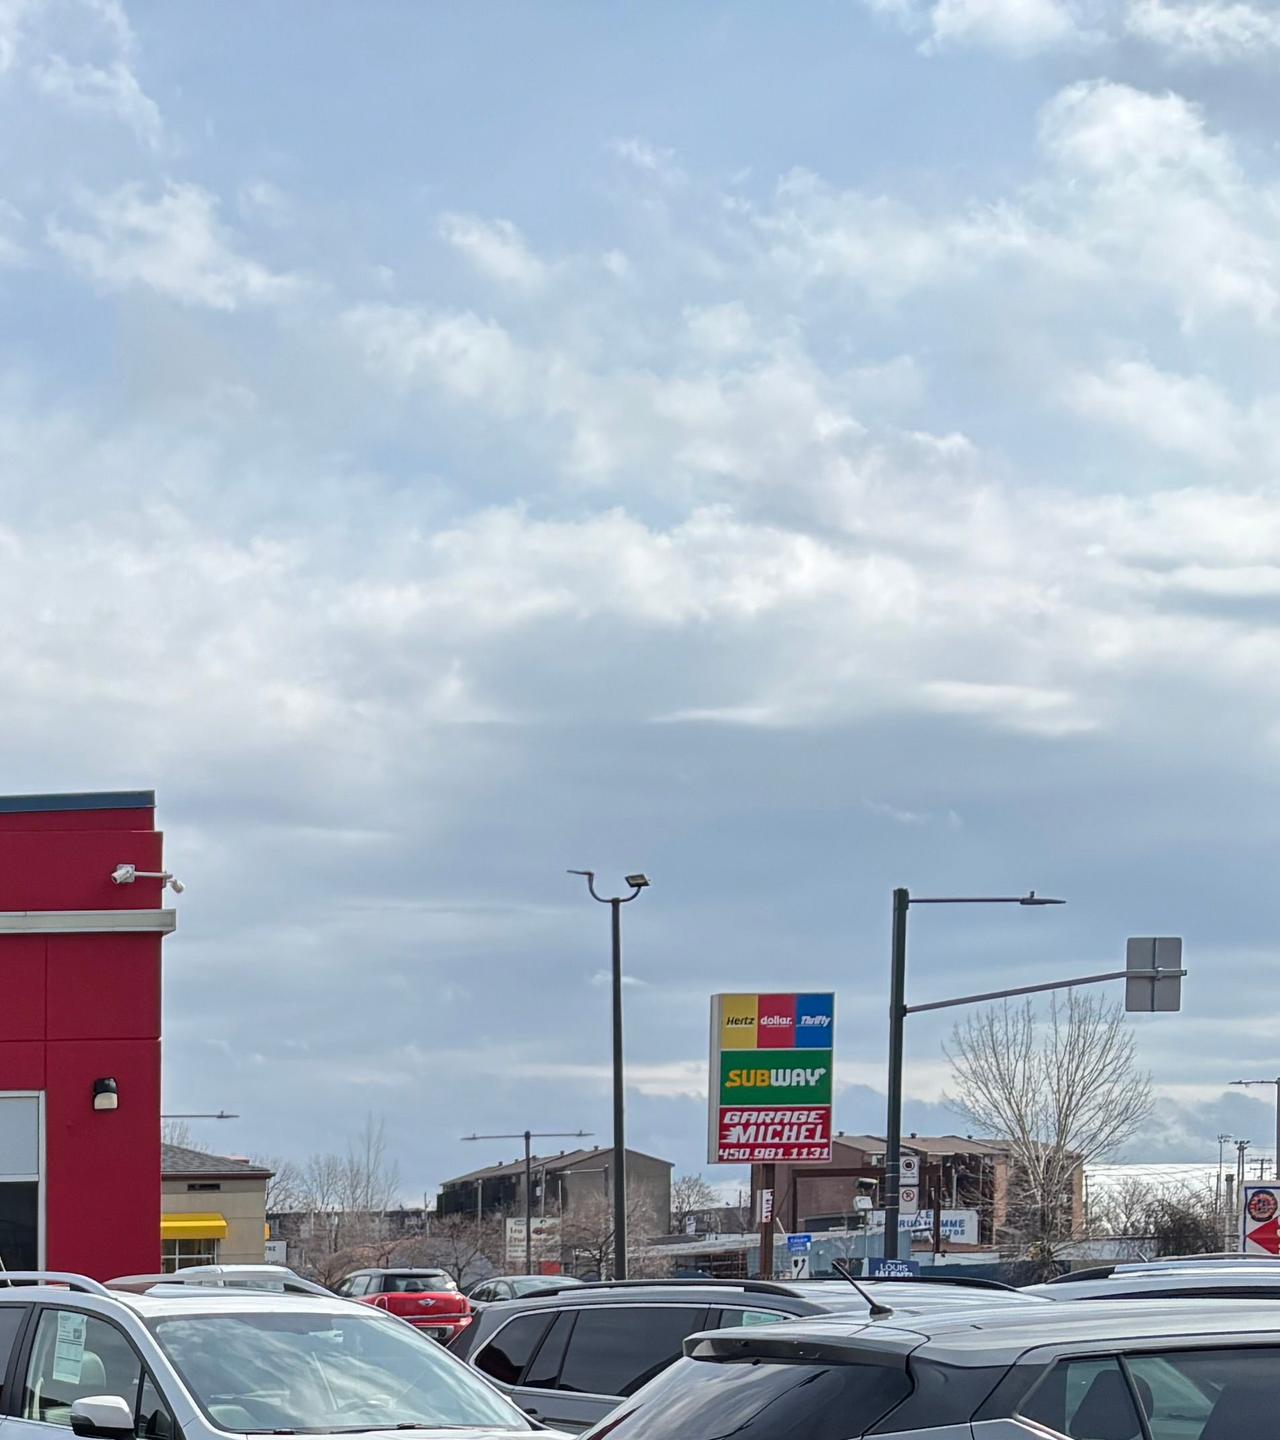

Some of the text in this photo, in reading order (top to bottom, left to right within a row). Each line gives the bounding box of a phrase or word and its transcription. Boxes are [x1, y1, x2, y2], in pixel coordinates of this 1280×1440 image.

[726, 1016, 755, 1026] Hertz
[799, 1015, 831, 1027] Thrifty
[725, 1067, 827, 1088] SUBWAY
[723, 1110, 827, 1124] GARAGE
[720, 1124, 828, 1143] MICHEL
[718, 1147, 830, 1161] 450.981.1131
[880, 1263, 909, 1272] LOUIS
